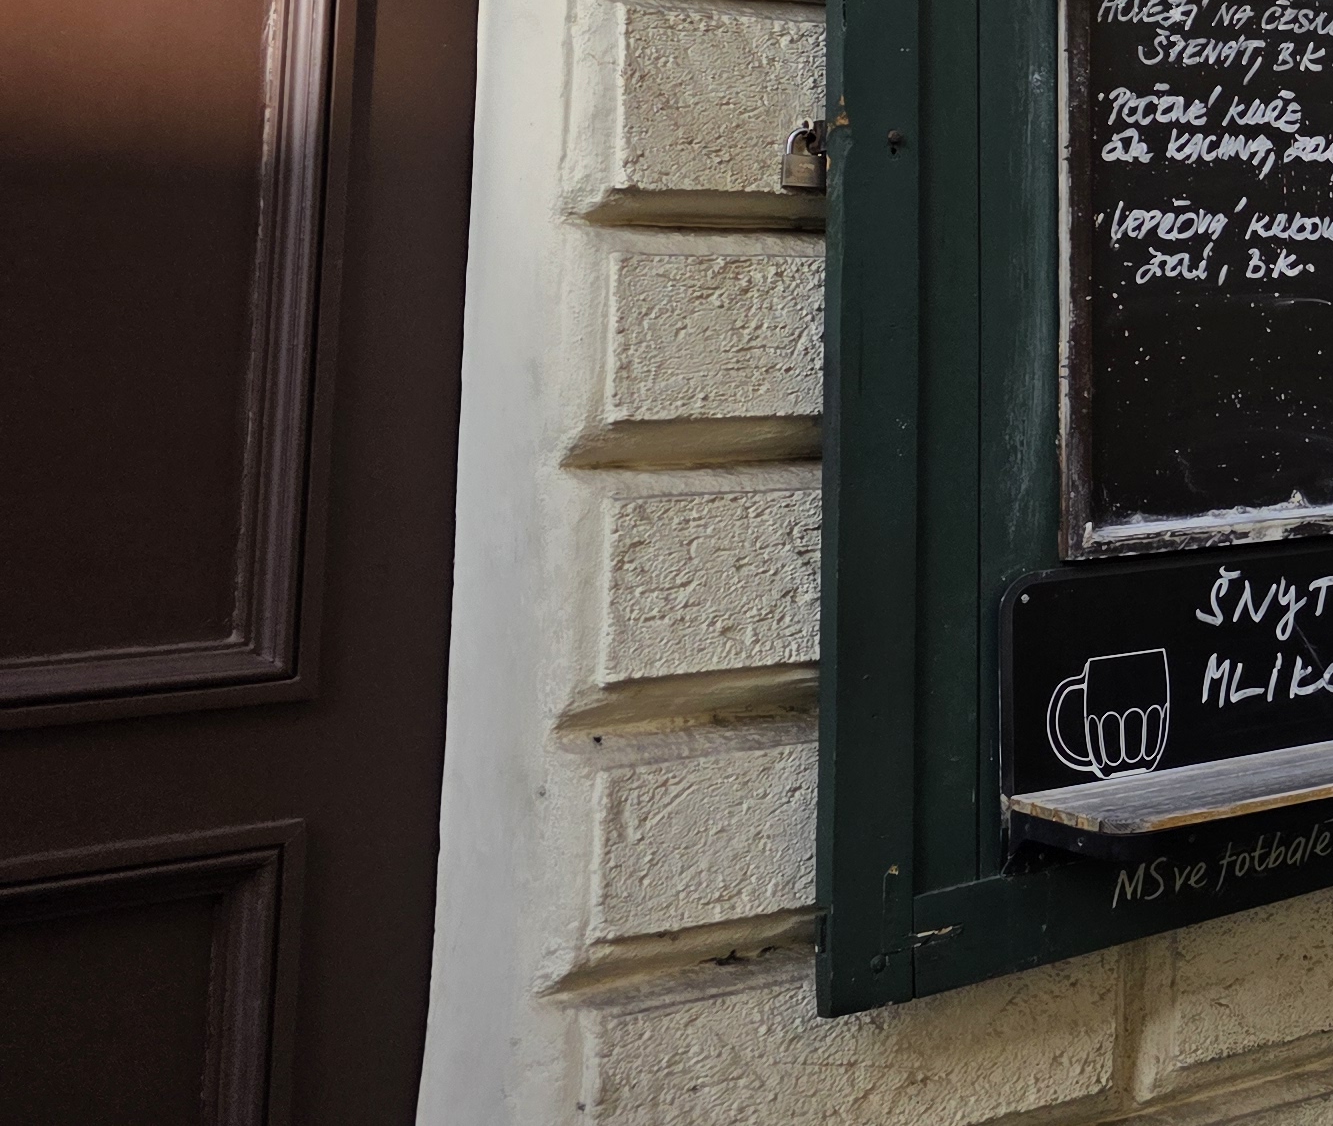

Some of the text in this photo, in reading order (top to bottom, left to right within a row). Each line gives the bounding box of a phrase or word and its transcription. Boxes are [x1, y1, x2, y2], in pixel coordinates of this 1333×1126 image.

[1211, 1, 1254, 30] NA
[1112, 857, 1167, 909] MS
[1174, 861, 1207, 894] ve
[1216, 823, 1331, 892] fotbale
